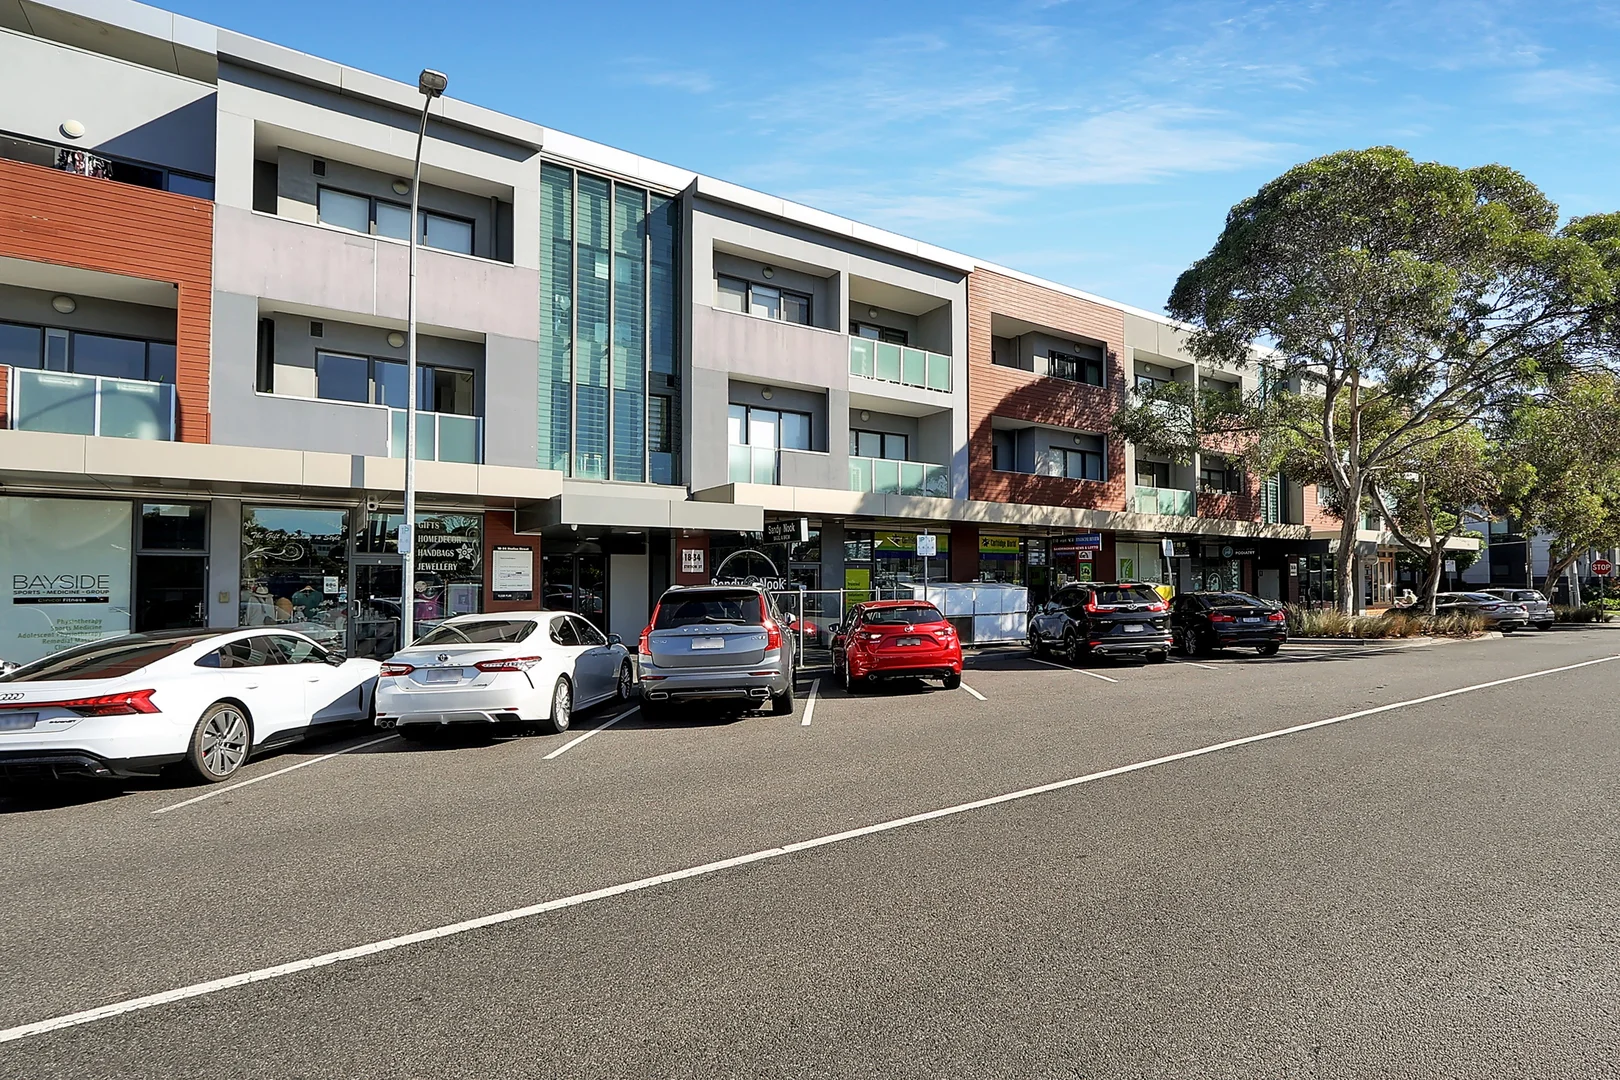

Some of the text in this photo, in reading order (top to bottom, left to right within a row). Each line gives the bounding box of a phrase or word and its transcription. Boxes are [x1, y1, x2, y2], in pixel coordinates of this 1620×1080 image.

[418, 521, 440, 530] GIFTS
[768, 522, 795, 535] Sandy Nook
[265, 532, 280, 540] Gift
[417, 535, 462, 544] HOMEDECOR
[417, 549, 455, 558] HANDBAGS
[684, 553, 702, 562] 18-34
[13, 575, 109, 589] BAYSIDE
